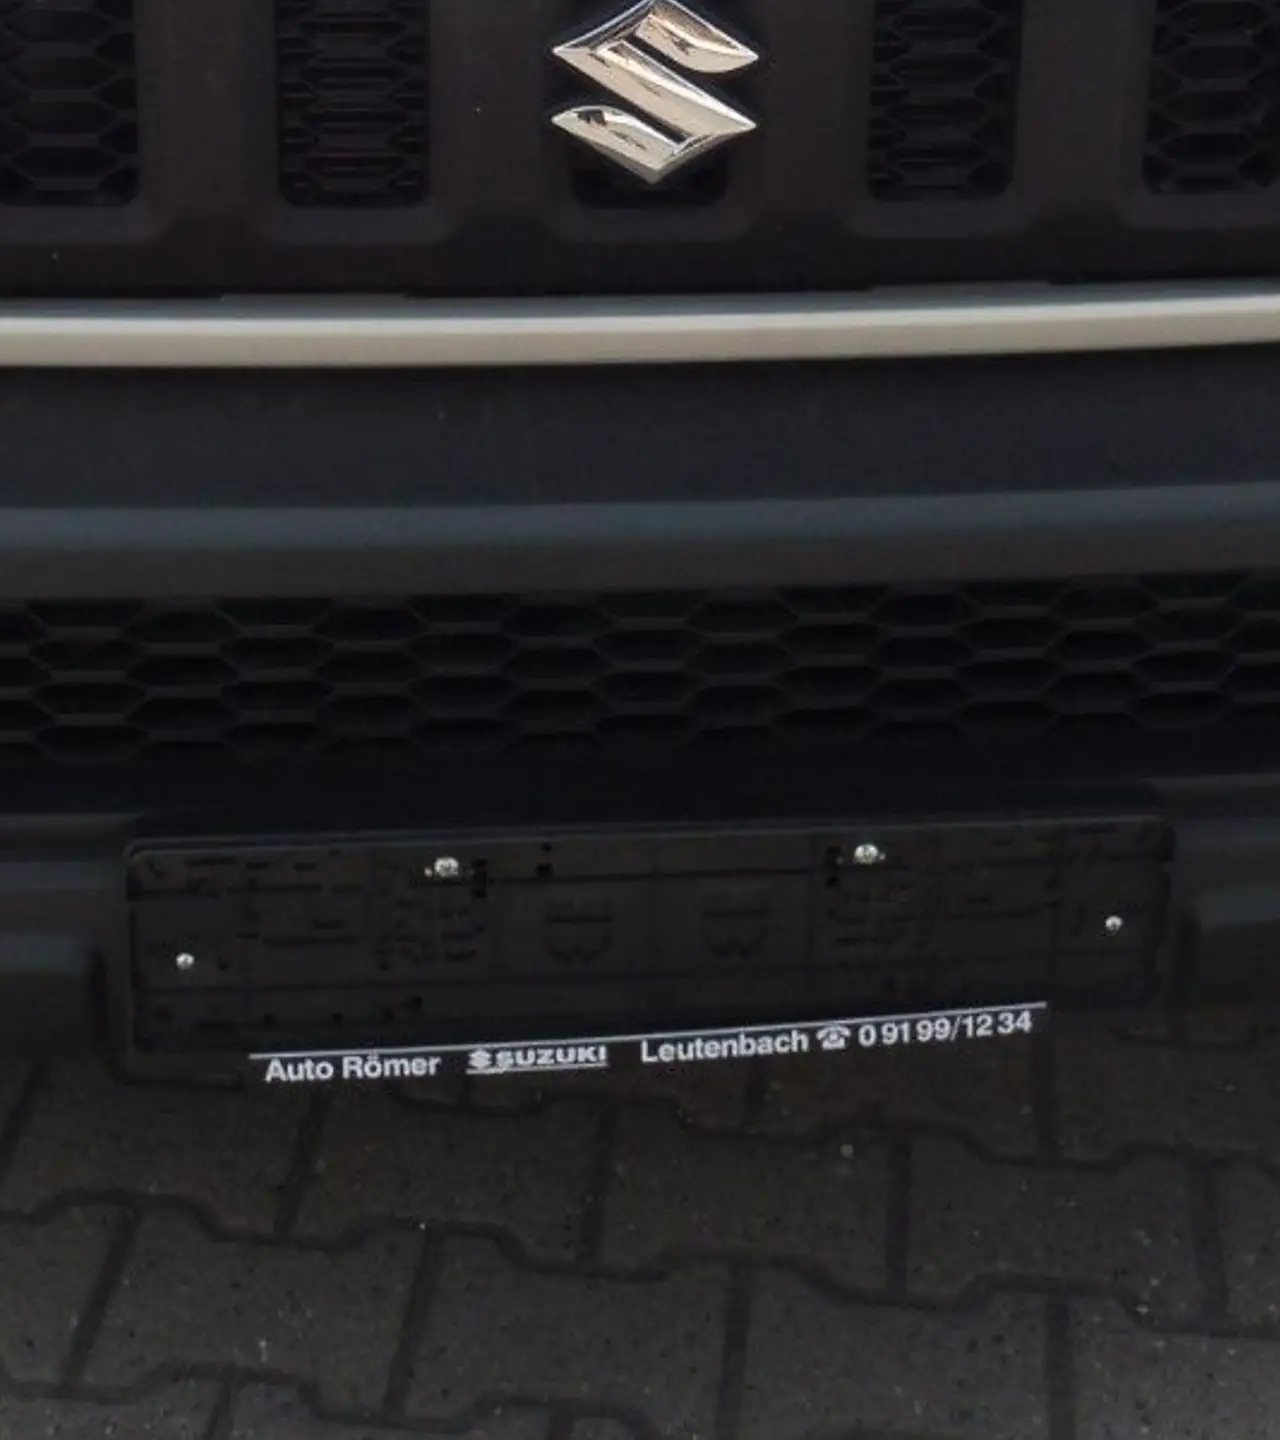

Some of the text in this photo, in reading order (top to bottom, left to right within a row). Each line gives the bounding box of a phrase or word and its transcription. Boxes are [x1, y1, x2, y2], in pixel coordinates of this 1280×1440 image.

[265, 1058, 334, 1082] Auto
[342, 1051, 440, 1079] Römer
[496, 1045, 608, 1068] SUZUKI
[641, 1028, 810, 1063] Leutenbach
